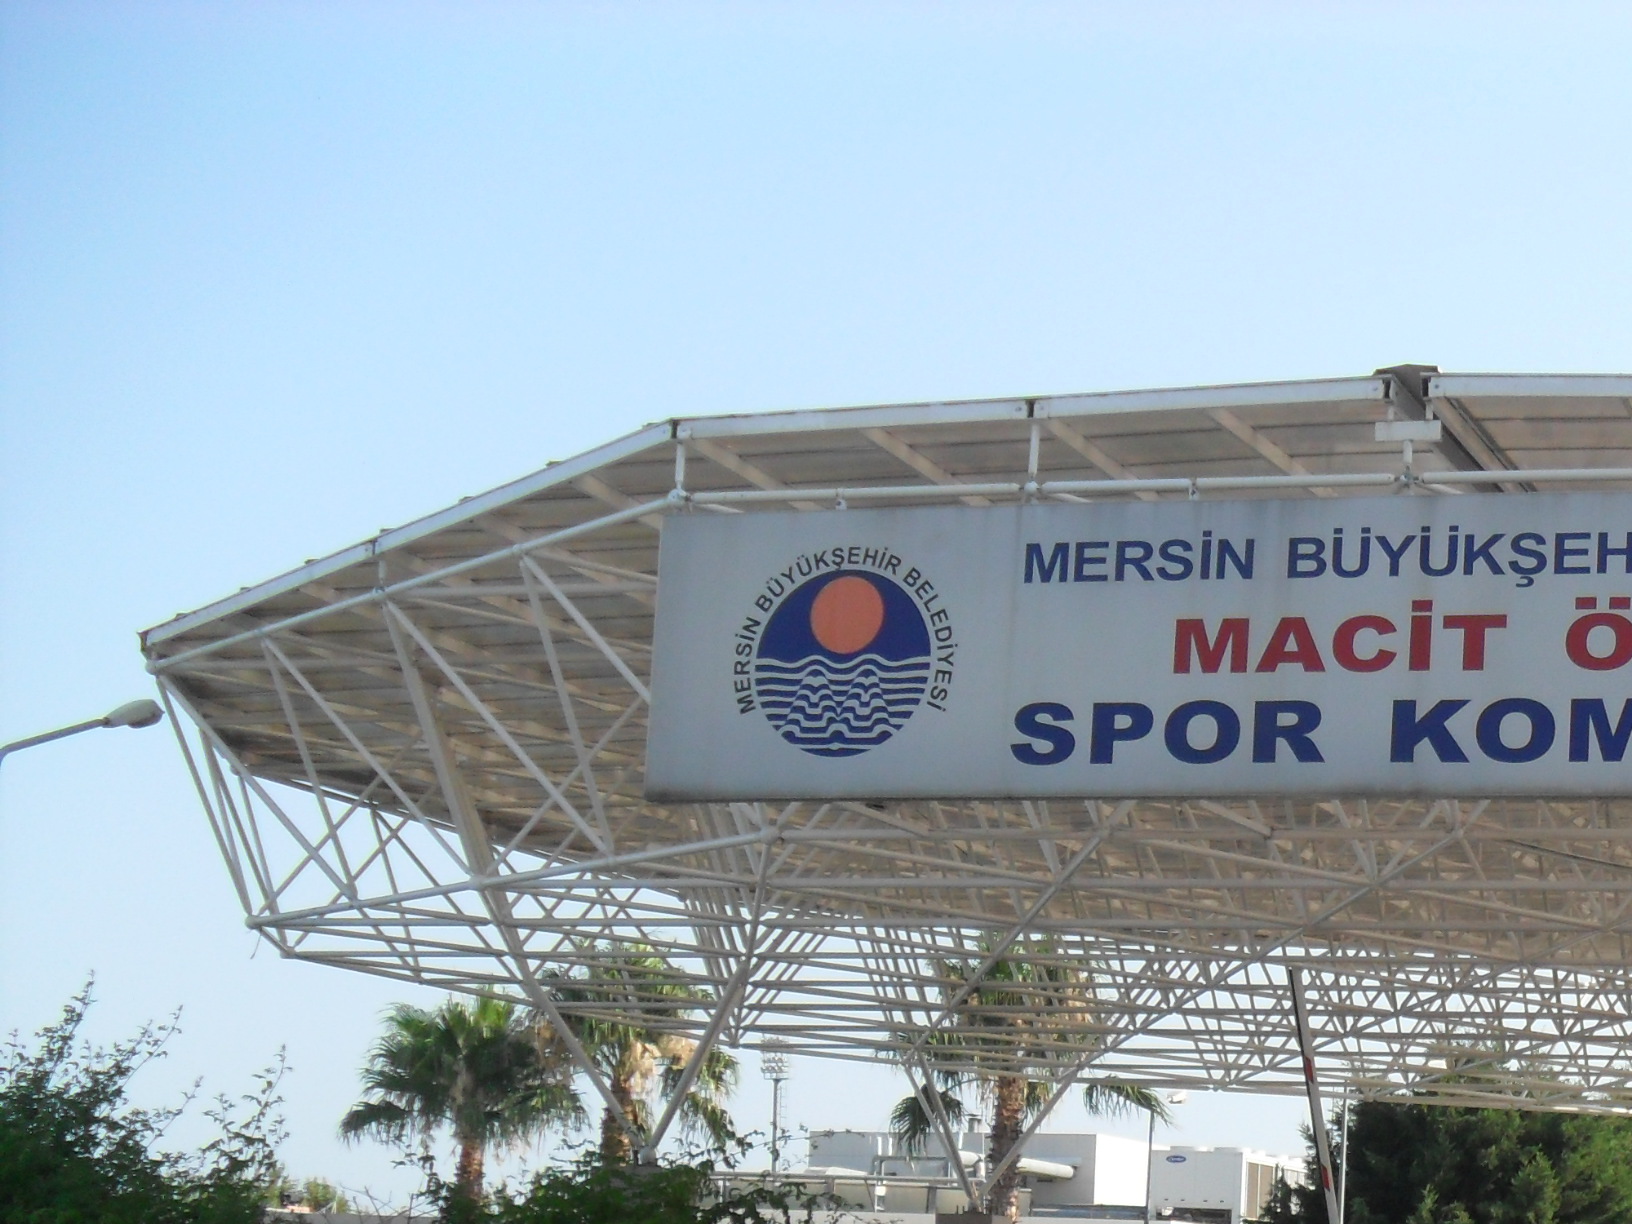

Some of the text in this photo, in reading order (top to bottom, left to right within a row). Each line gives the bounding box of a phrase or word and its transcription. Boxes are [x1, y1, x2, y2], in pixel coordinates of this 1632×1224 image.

[1023, 530, 1255, 584] MERSİN
[734, 546, 959, 715] MERSİN BÜYÜKŞEHİR BELEDİYESİ
[1172, 600, 1507, 674] MACİT
[1009, 700, 1326, 766] SPOR
